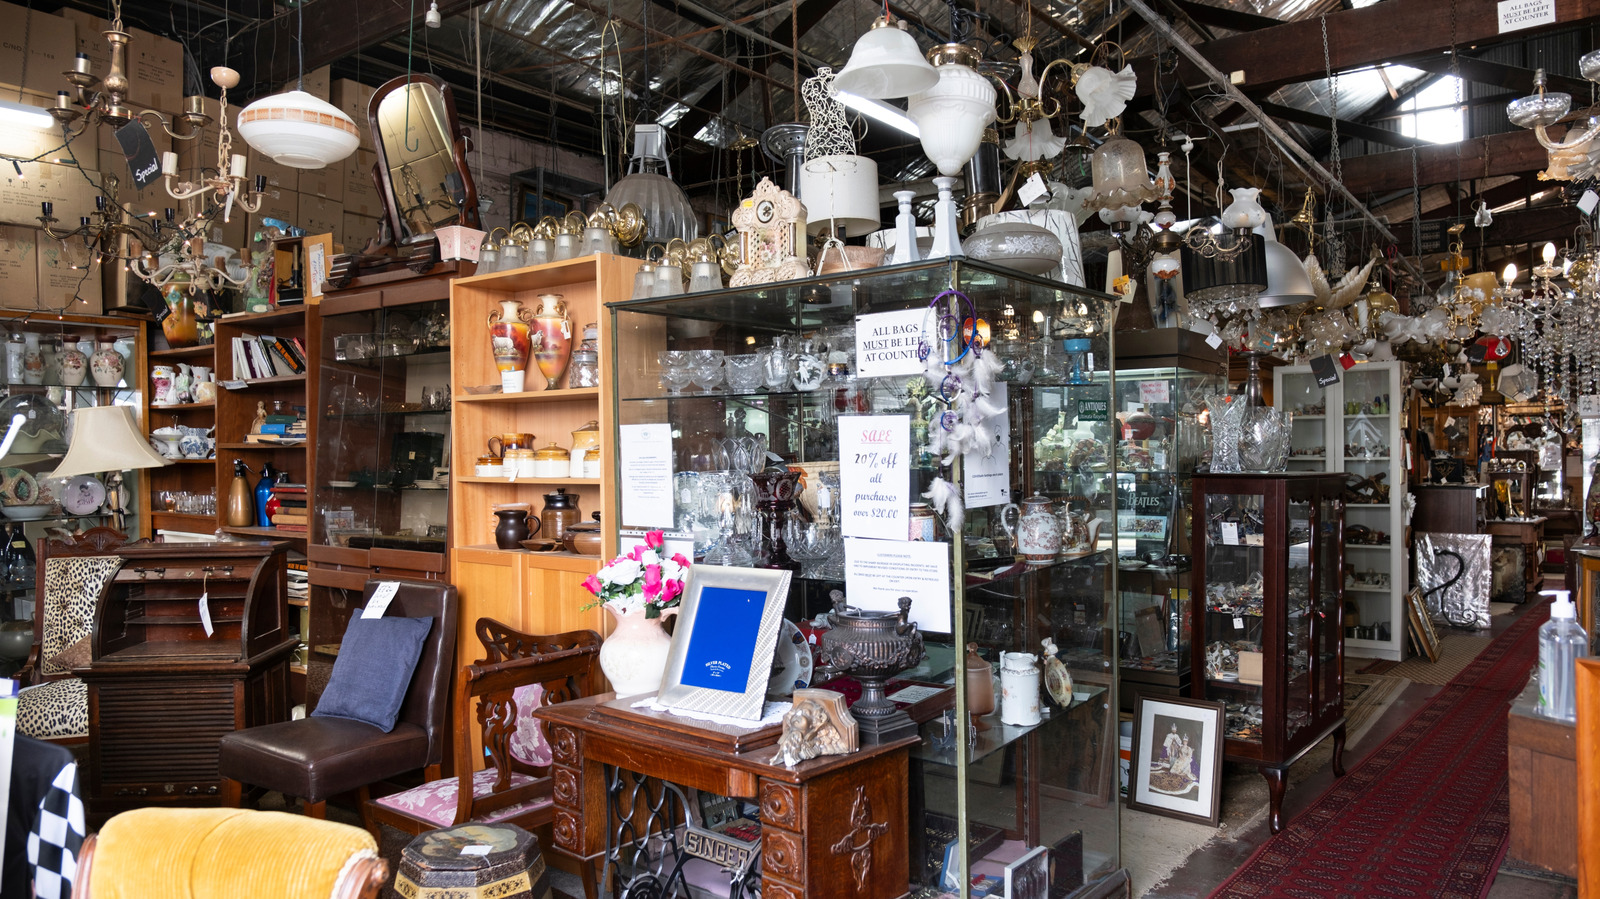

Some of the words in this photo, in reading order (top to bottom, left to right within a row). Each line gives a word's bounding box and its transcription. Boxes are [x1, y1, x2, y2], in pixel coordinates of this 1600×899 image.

[1524, 0, 1542, 8] BAGS
[1503, 10, 1522, 19] MUST
[1533, 4, 1550, 13] LEFT
[1514, 11, 1549, 23] COUNTER
[135, 157, 159, 183] Special
[872, 327, 891, 337] ALL
[894, 323, 919, 335] BAGS
[863, 340, 889, 351] MUST
[891, 338, 903, 347] BE
[865, 353, 880, 362] AT
[1319, 373, 1337, 386] Special
[1084, 401, 1107, 413] ANTIQUES
[860, 429, 893, 444] SALE
[855, 452, 879, 469] 20%
[880, 452, 898, 469] off
[869, 473, 883, 484] all
[854, 490, 897, 503] purchases
[1128, 492, 1160, 508] BEATLES
[853, 508, 869, 517] over
[871, 507, 899, 519] $20.00
[687, 833, 748, 868] SINGER
